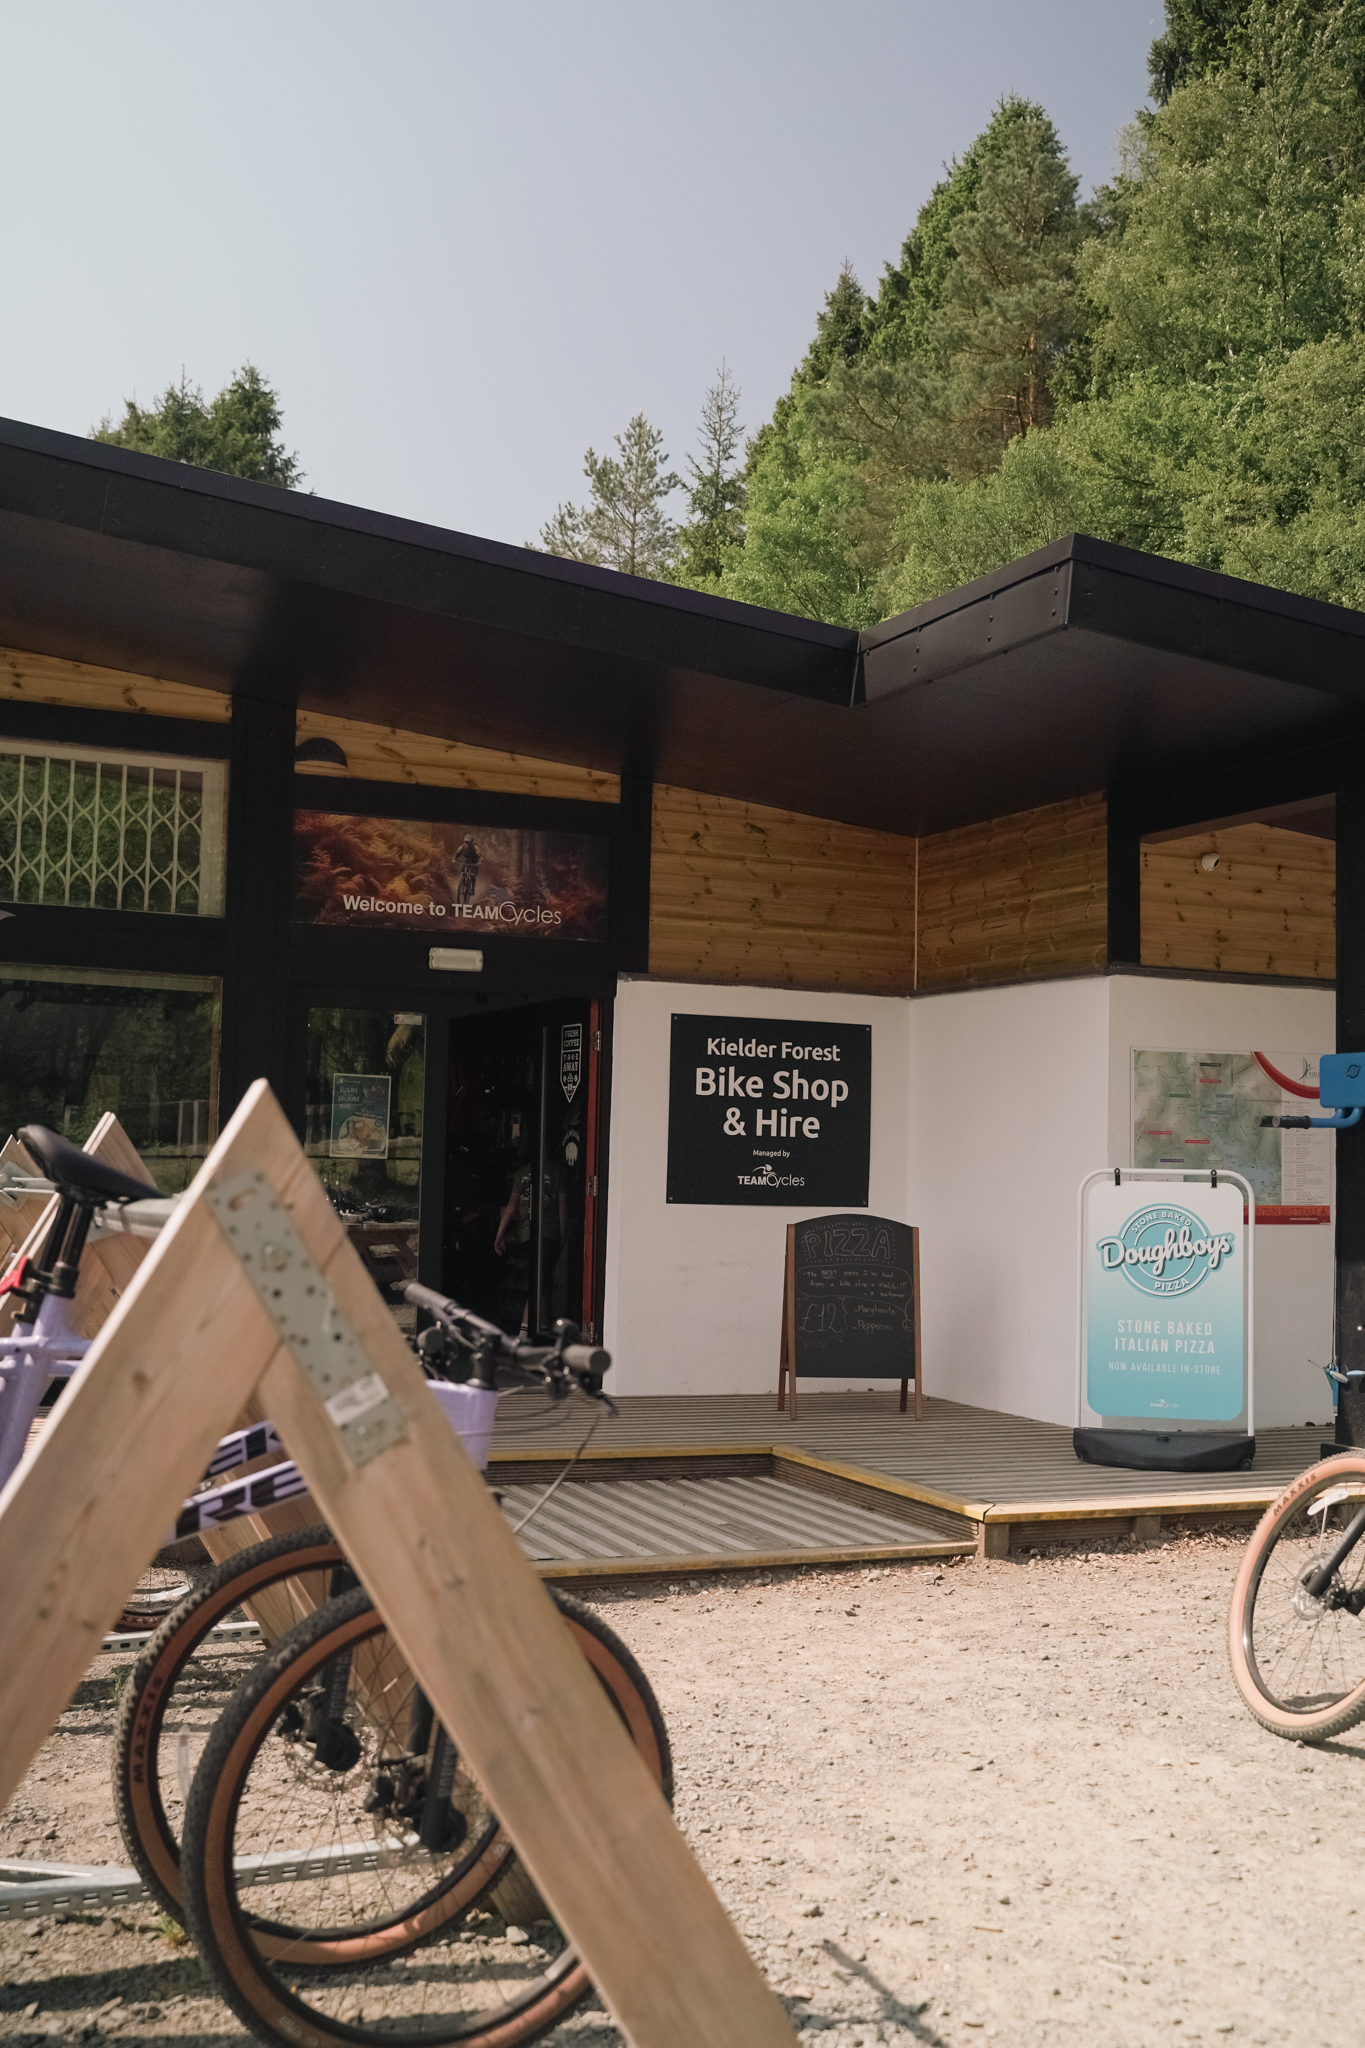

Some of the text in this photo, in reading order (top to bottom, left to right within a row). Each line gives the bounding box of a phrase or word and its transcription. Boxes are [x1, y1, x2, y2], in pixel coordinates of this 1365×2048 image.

[343, 895, 424, 915] Welcome
[429, 901, 446, 917] to
[563, 1038, 580, 1048] COFFEE
[564, 1029, 579, 1038] FRESH
[707, 1037, 841, 1062] Kielder Forest
[563, 1061, 579, 1072] AWAY
[695, 1066, 849, 1108] Bike Shop
[722, 1107, 821, 1139] & Hire
[752, 1149, 791, 1159] Managed by
[1281, 1207, 1295, 1217] BIKE
[1296, 1207, 1319, 1217] TRAILS
[1131, 1211, 1193, 1234] STONE BAKED
[804, 1228, 891, 1260] PIZZA
[1098, 1226, 1233, 1278] Doughboys
[809, 1280, 825, 1288] from
[1154, 1277, 1191, 1291] PIZZA
[799, 1302, 844, 1334] £12
[1117, 1319, 1213, 1336] STONE BAKED
[1114, 1337, 1216, 1354] ITALIAN PIZZA
[1108, 1361, 1222, 1375] NOW AVAILABLE IN-STORE
[1272, 1472, 1317, 1516] MAXXIS
[133, 1675, 163, 1784] MAXXIS
